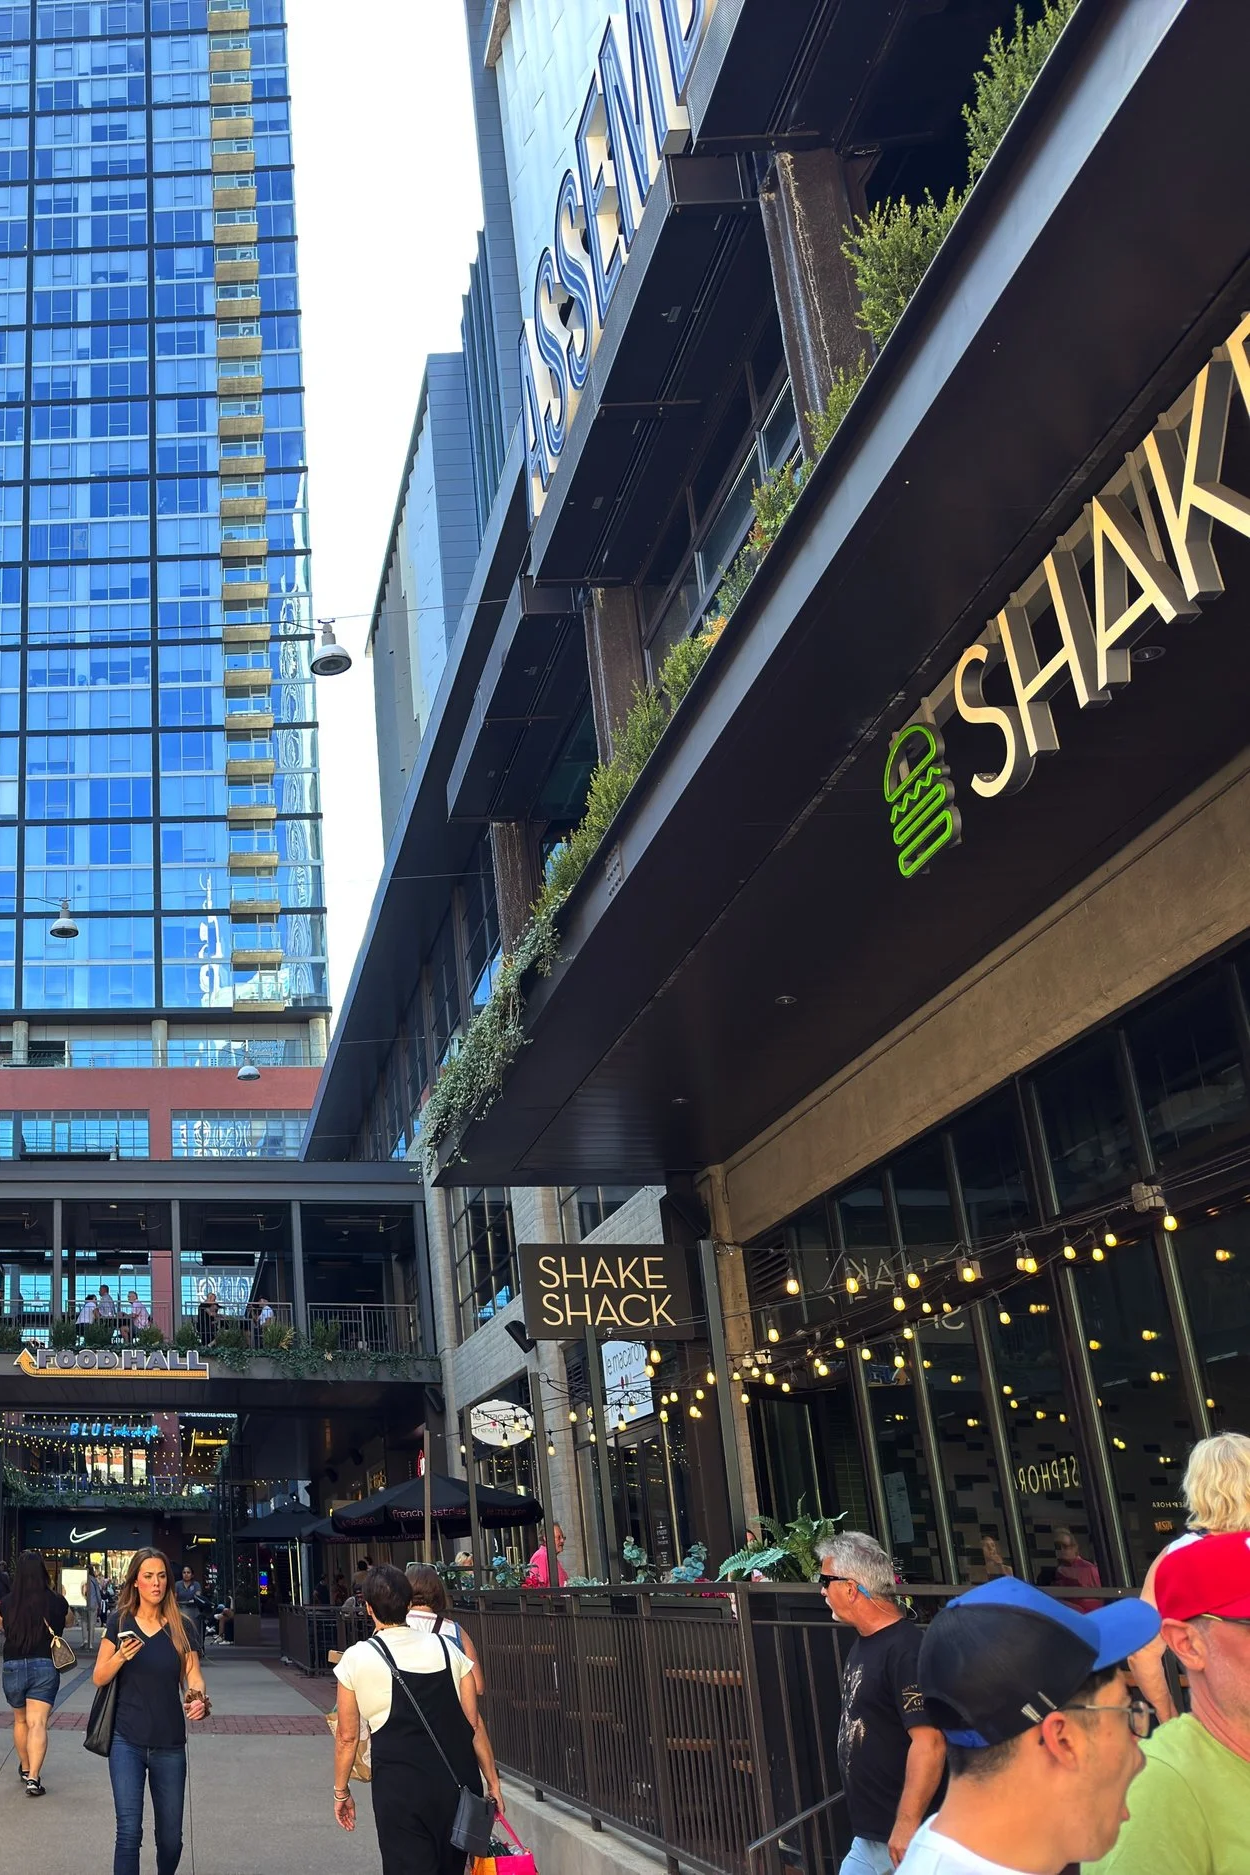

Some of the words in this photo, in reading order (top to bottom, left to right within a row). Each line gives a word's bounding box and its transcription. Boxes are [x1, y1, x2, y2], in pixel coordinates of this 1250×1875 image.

[538, 1256, 668, 1289] SHAKE
[542, 1293, 677, 1327] SHACK
[36, 1348, 119, 1370] FOOD
[121, 1348, 208, 1371] HALL
[69, 1422, 113, 1437] BLUE
[391, 1508, 424, 1519] french
[425, 1506, 467, 1518] astries
